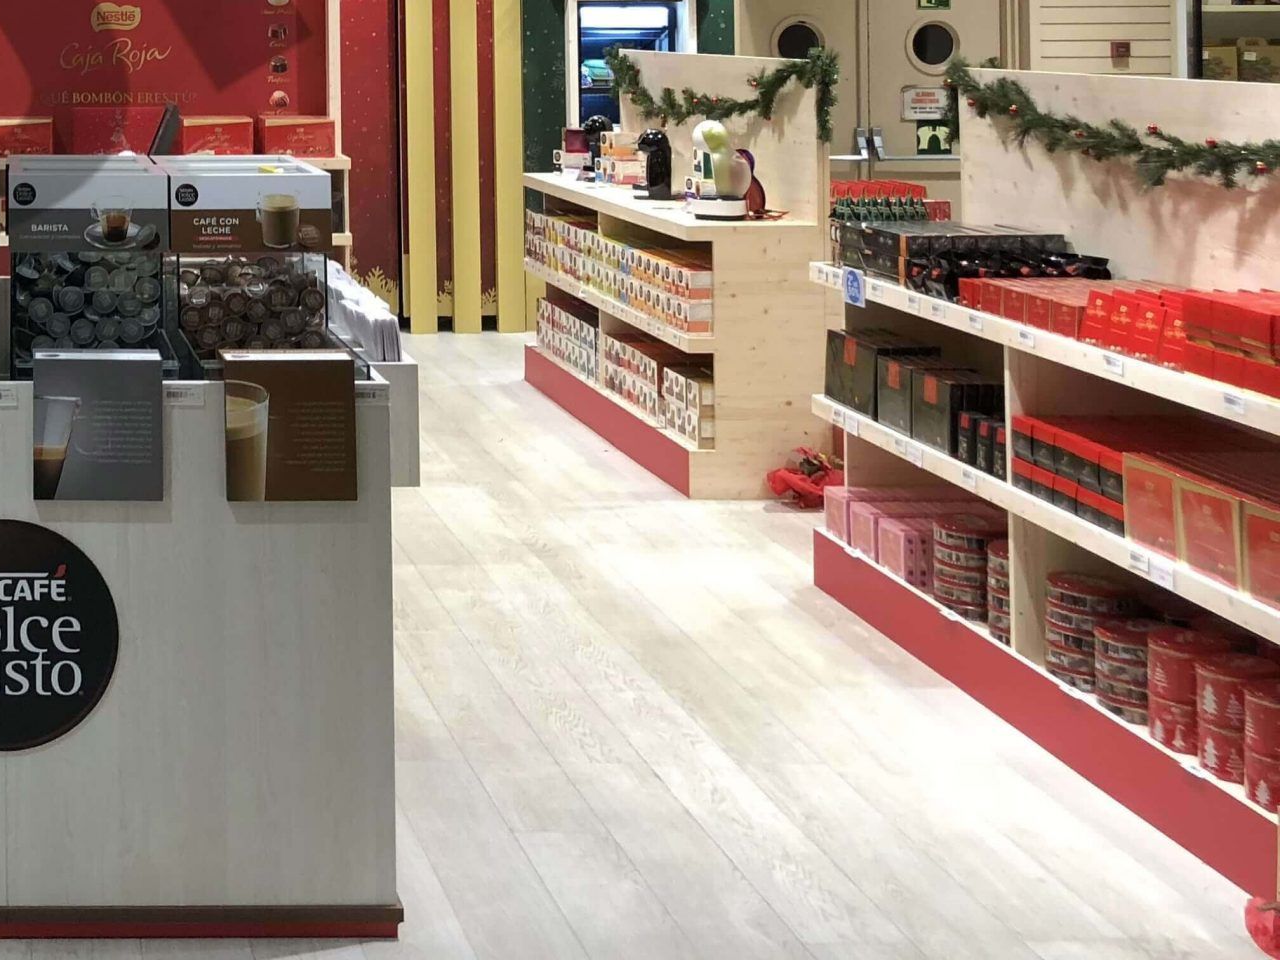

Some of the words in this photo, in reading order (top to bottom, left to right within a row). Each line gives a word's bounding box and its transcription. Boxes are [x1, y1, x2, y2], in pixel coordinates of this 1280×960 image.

[96, 10, 136, 22] Nestlé
[59, 42, 104, 76] Caja
[104, 37, 172, 74] Roja
[193, 216, 217, 226] CAFÉ
[219, 217, 240, 226] CON
[31, 223, 69, 232] BARISTA
[201, 226, 231, 235] LECHE
